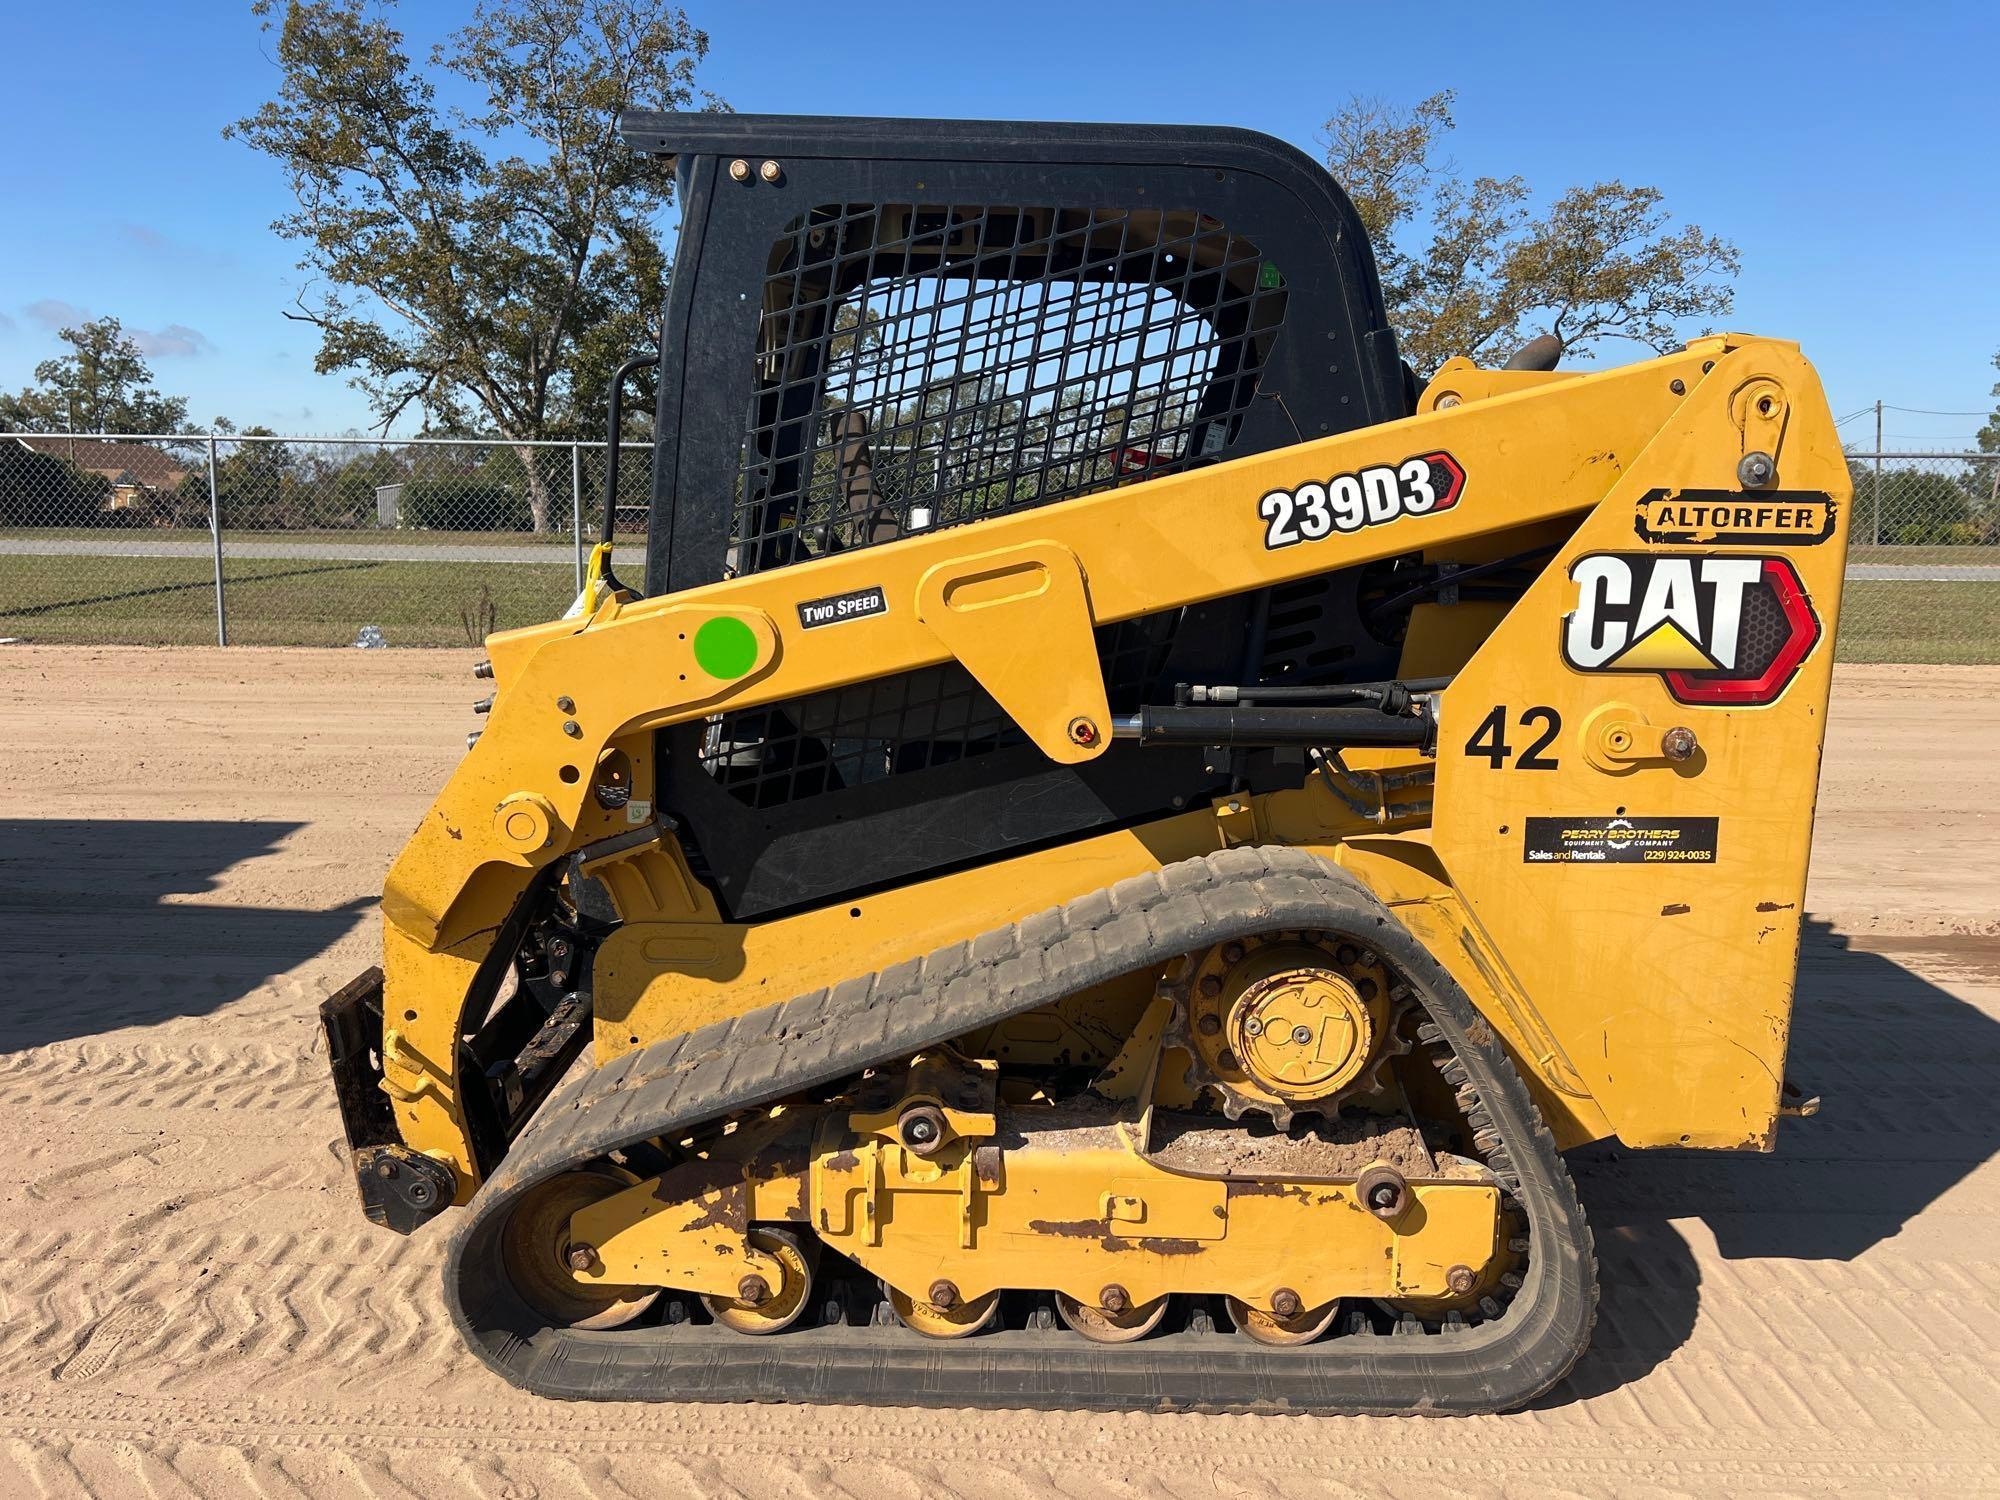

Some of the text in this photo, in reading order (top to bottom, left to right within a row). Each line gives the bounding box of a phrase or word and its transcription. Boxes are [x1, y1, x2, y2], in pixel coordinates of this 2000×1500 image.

[1261, 459, 1435, 547] 239D3
[1656, 506, 1815, 529] ALTORFER
[803, 595, 879, 623] TWO SPEED
[1567, 555, 1762, 670] CAT
[1464, 705, 1562, 771] 42
[1561, 829, 1681, 840] PERRY BROTHERS
[1529, 850, 1553, 860] Sales
[1571, 850, 1606, 860] Rentals
[1643, 850, 1711, 861] (229) 924-0035
